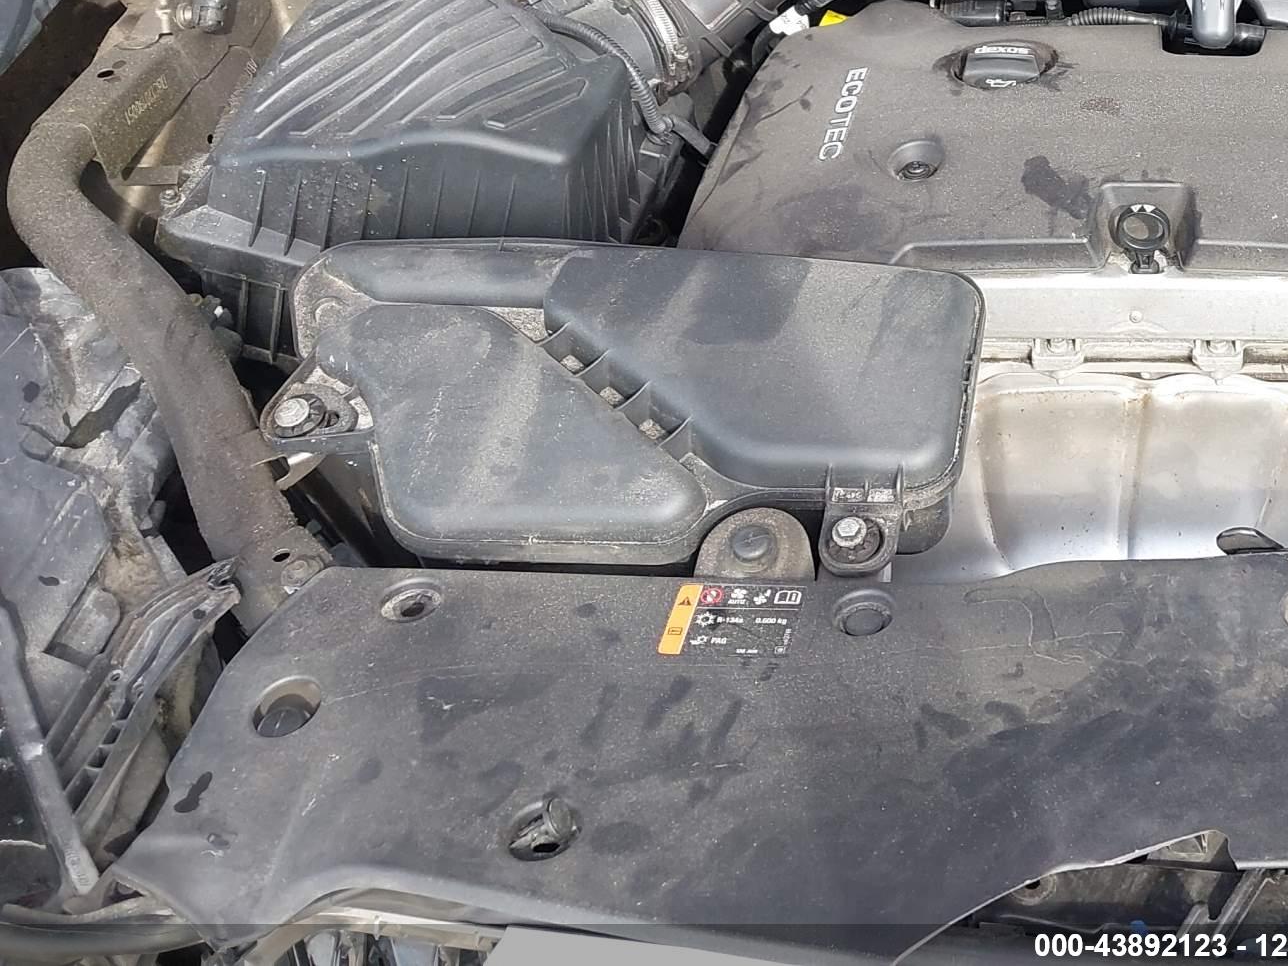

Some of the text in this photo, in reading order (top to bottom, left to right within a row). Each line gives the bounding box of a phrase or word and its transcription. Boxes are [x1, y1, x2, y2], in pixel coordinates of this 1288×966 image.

[974, 45, 1029, 55] dexos
[818, 67, 868, 160] ECOTEC
[716, 616, 744, 624] R-134a
[777, 617, 788, 625] kg
